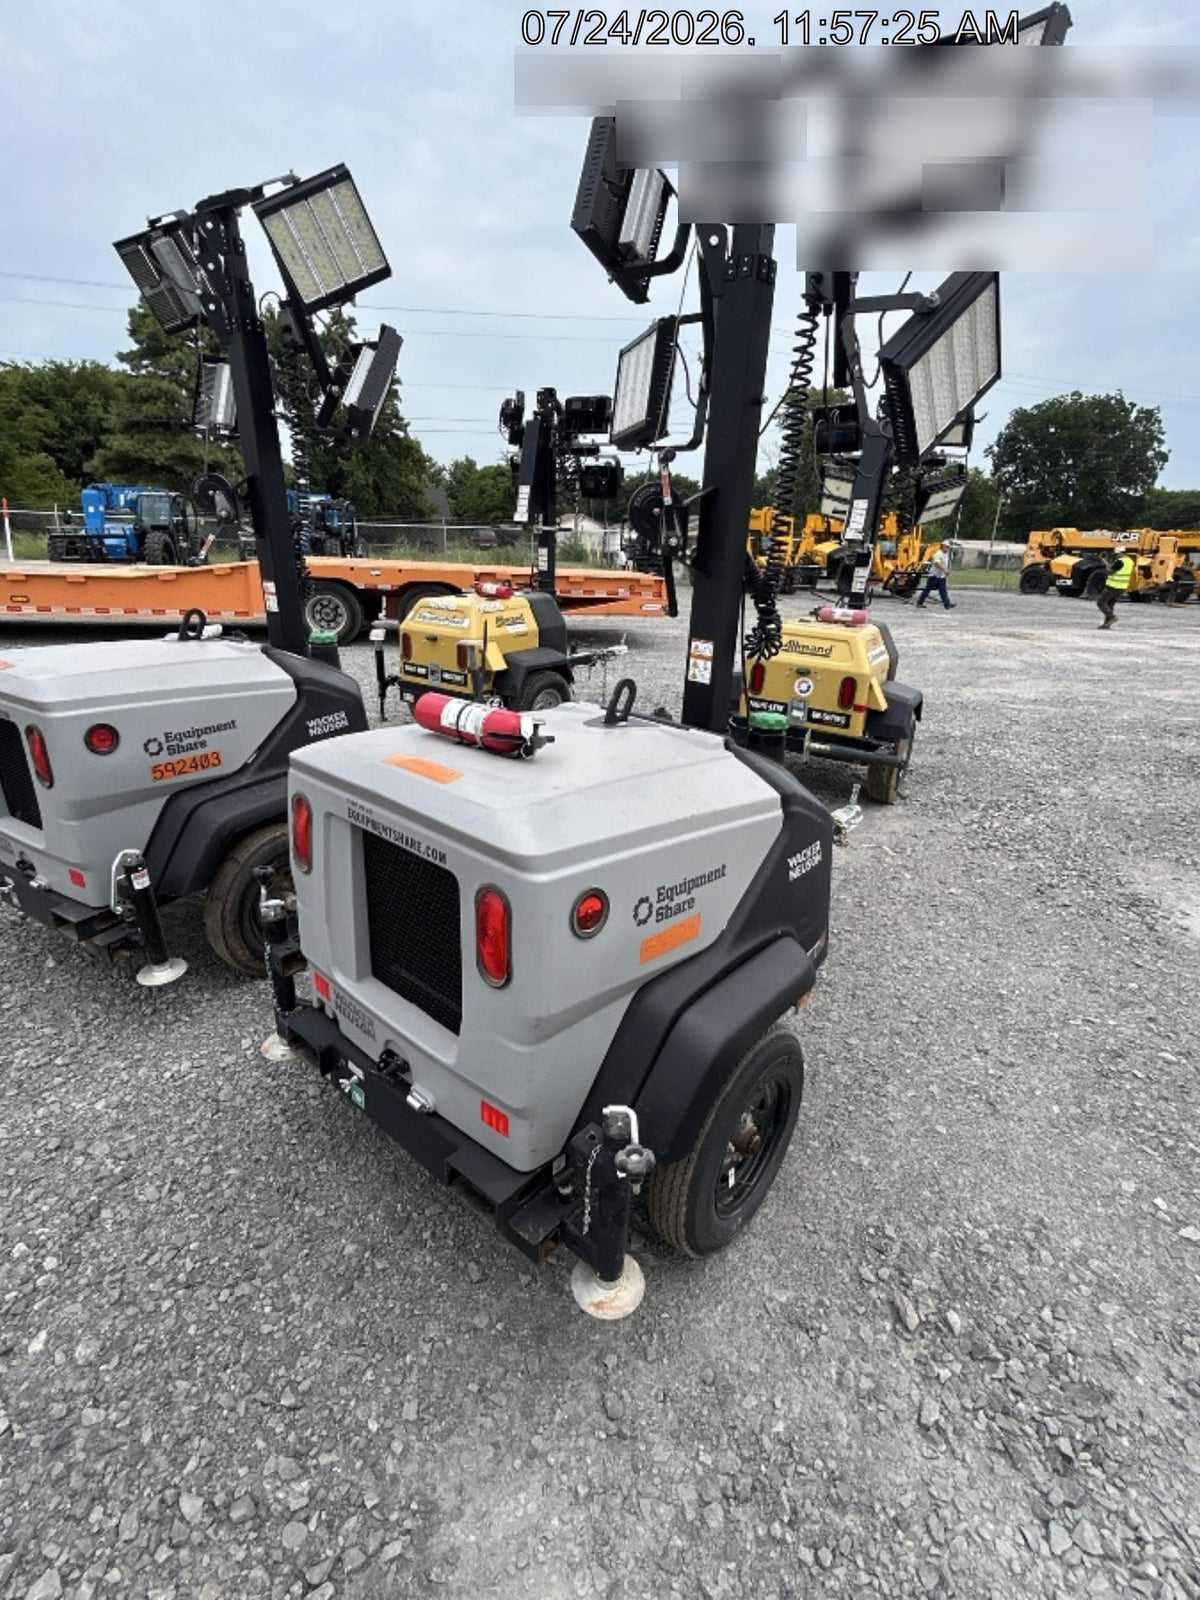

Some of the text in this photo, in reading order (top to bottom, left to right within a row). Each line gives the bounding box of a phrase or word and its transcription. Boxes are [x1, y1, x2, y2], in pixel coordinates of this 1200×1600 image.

[1111, 531, 1140, 543] JCB
[163, 719, 237, 744] Equipment
[306, 710, 346, 728] WACKER
[308, 717, 349, 737] NEUSON
[166, 739, 208, 757] Share
[150, 751, 222, 781] 592403
[347, 806, 447, 866] EQUIPMENTSHARE.COM
[787, 840, 821, 868] WACKER
[788, 850, 822, 882] NEUSON
[655, 862, 727, 904] Equipment
[655, 896, 695, 924] Share
